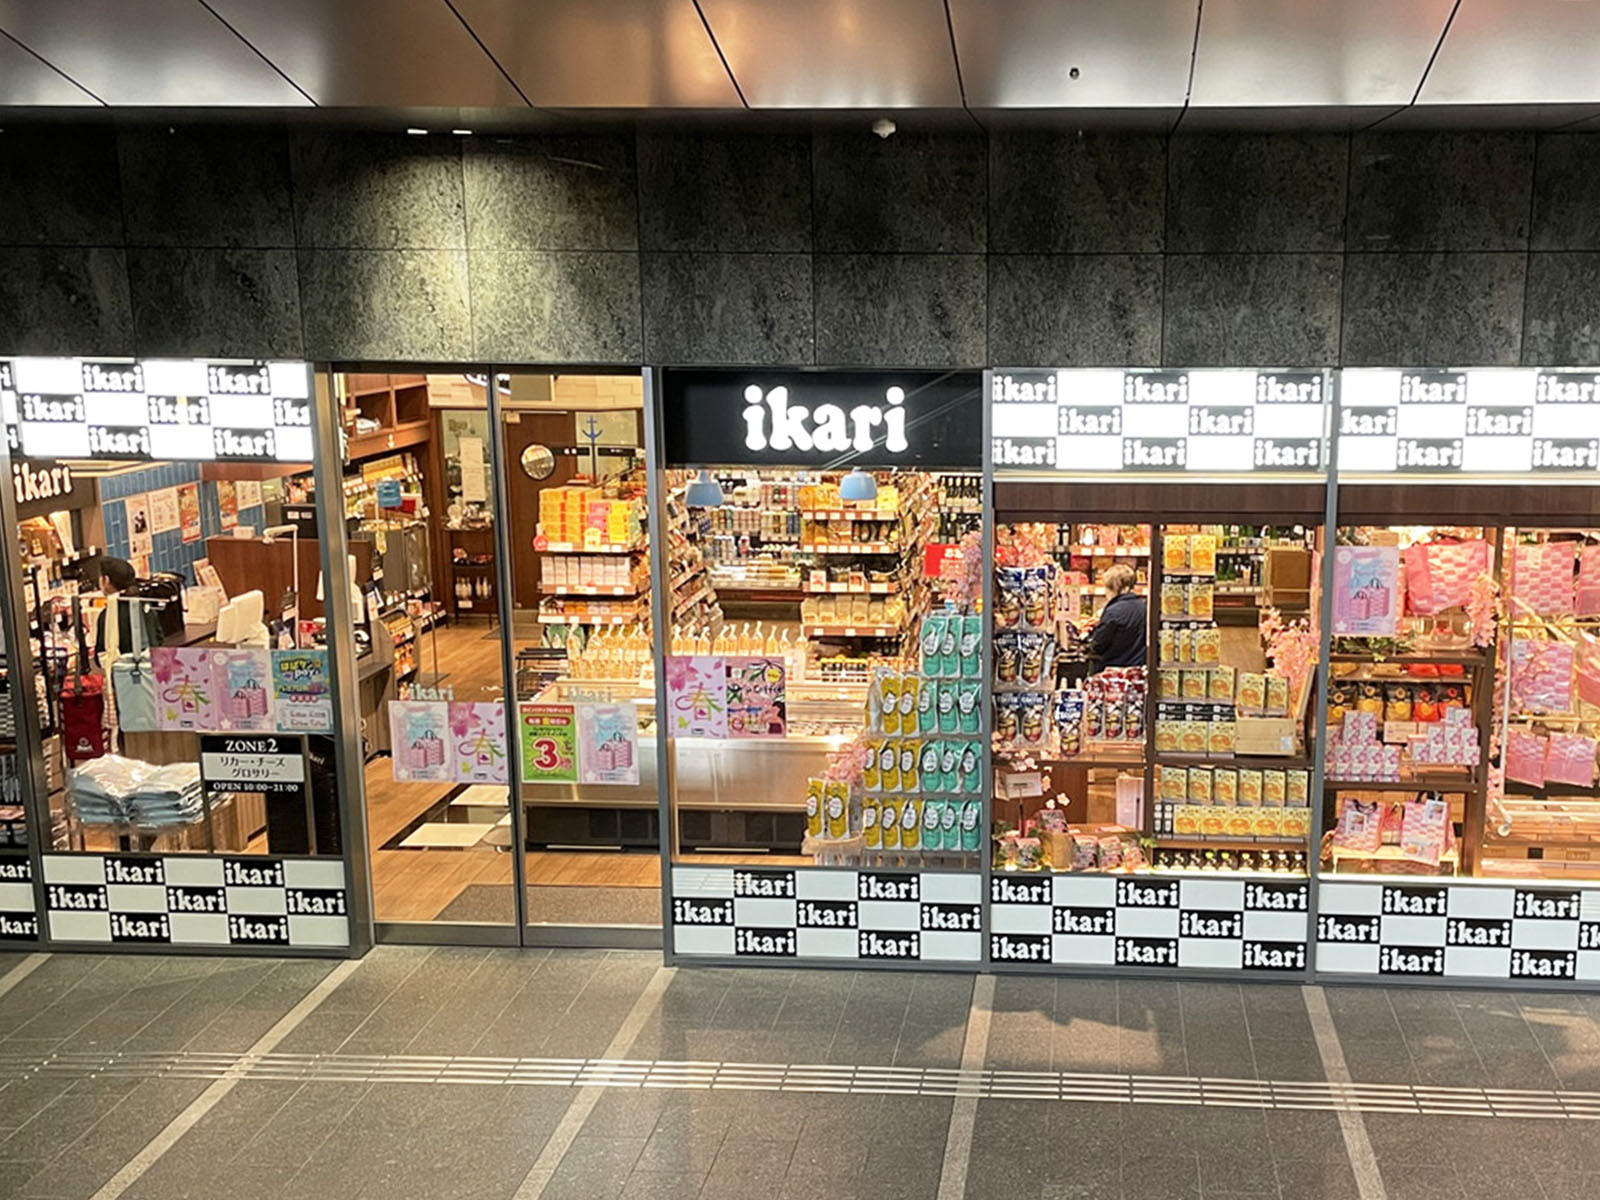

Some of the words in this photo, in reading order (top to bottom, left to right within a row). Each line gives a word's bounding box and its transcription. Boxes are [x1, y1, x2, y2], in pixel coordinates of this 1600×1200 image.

[83, 365, 144, 392] ikari
[209, 367, 269, 393] ikari
[994, 375, 1056, 402] ikari
[1125, 376, 1188, 403] ikari
[1257, 377, 1320, 403] ikari
[1401, 376, 1466, 402] ikari
[23, 395, 85, 421] ikari
[150, 398, 209, 424] ikari
[743, 385, 909, 452] ikari
[1059, 407, 1121, 434] ikari
[1190, 408, 1253, 435] ikari
[1340, 409, 1397, 434] kari
[1468, 409, 1532, 434] ikari
[88, 428, 149, 453] ikari
[215, 429, 275, 455] ikari
[993, 440, 1056, 464] ikari
[1124, 440, 1186, 465] ikari
[1255, 441, 1318, 465] ikari
[1398, 440, 1462, 466] ikari
[1533, 441, 1598, 466] ikari
[13, 463, 72, 502] ikari
[533, 738, 559, 770] 3
[231, 768, 280, 778] グロサリー
[213, 782, 241, 791] OPEN
[106, 860, 163, 883] ikari
[225, 860, 283, 886] ikari
[736, 873, 794, 897] ikari
[860, 876, 918, 900] ikari
[992, 880, 1050, 903] ikari
[1118, 882, 1178, 905] ikari
[1246, 884, 1306, 909] ikari
[50, 886, 107, 909] ikari
[169, 889, 226, 911] ikari
[288, 891, 345, 914] ikari
[1384, 889, 1446, 914] ikari
[1516, 892, 1579, 916] ikari
[675, 900, 733, 923] ikari
[798, 902, 857, 926] ikari
[922, 906, 980, 929] ikari
[1054, 909, 1113, 932] ikari
[112, 914, 169, 937] ikari
[230, 916, 288, 940] ikari
[1181, 912, 1241, 937] ikari
[1318, 917, 1380, 940] ikari
[1448, 921, 1510, 944] ikari
[736, 932, 795, 953] ikari
[860, 933, 919, 957] ikari
[992, 937, 1050, 961] ikari
[1117, 940, 1177, 964] ikari
[1244, 944, 1305, 968] ikari
[1381, 950, 1443, 971] ikari
[1512, 954, 1574, 976] ikari
